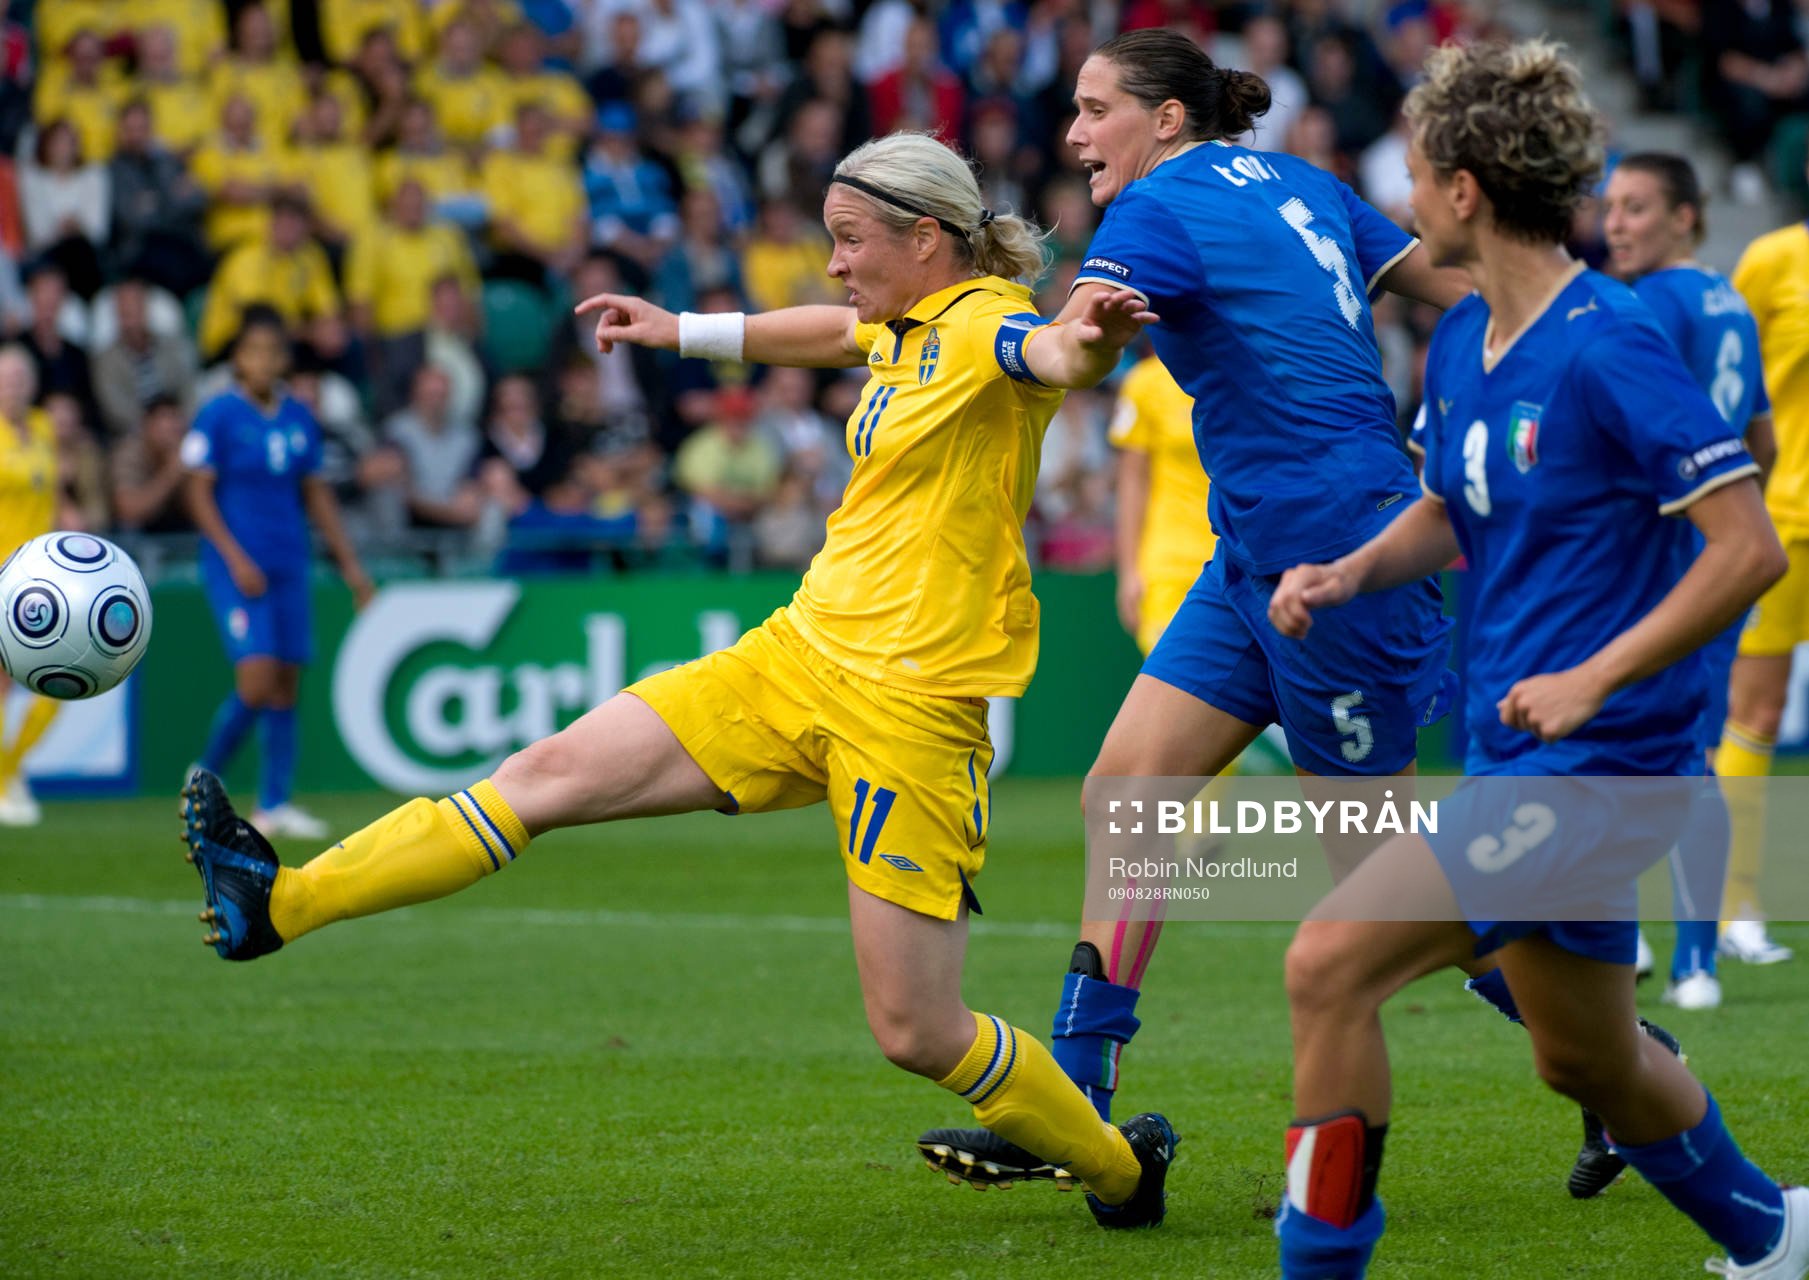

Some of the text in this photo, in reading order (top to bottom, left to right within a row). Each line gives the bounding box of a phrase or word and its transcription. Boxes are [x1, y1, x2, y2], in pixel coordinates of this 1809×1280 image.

[1278, 197, 1362, 331] 5
[1711, 329, 1744, 422] 6
[855, 385, 897, 457] 11
[1463, 420, 1491, 517] 3
[333, 578, 740, 797] Carl
[1331, 690, 1374, 763] 5
[848, 777, 897, 865] 11
[1467, 803, 1557, 873] 3
